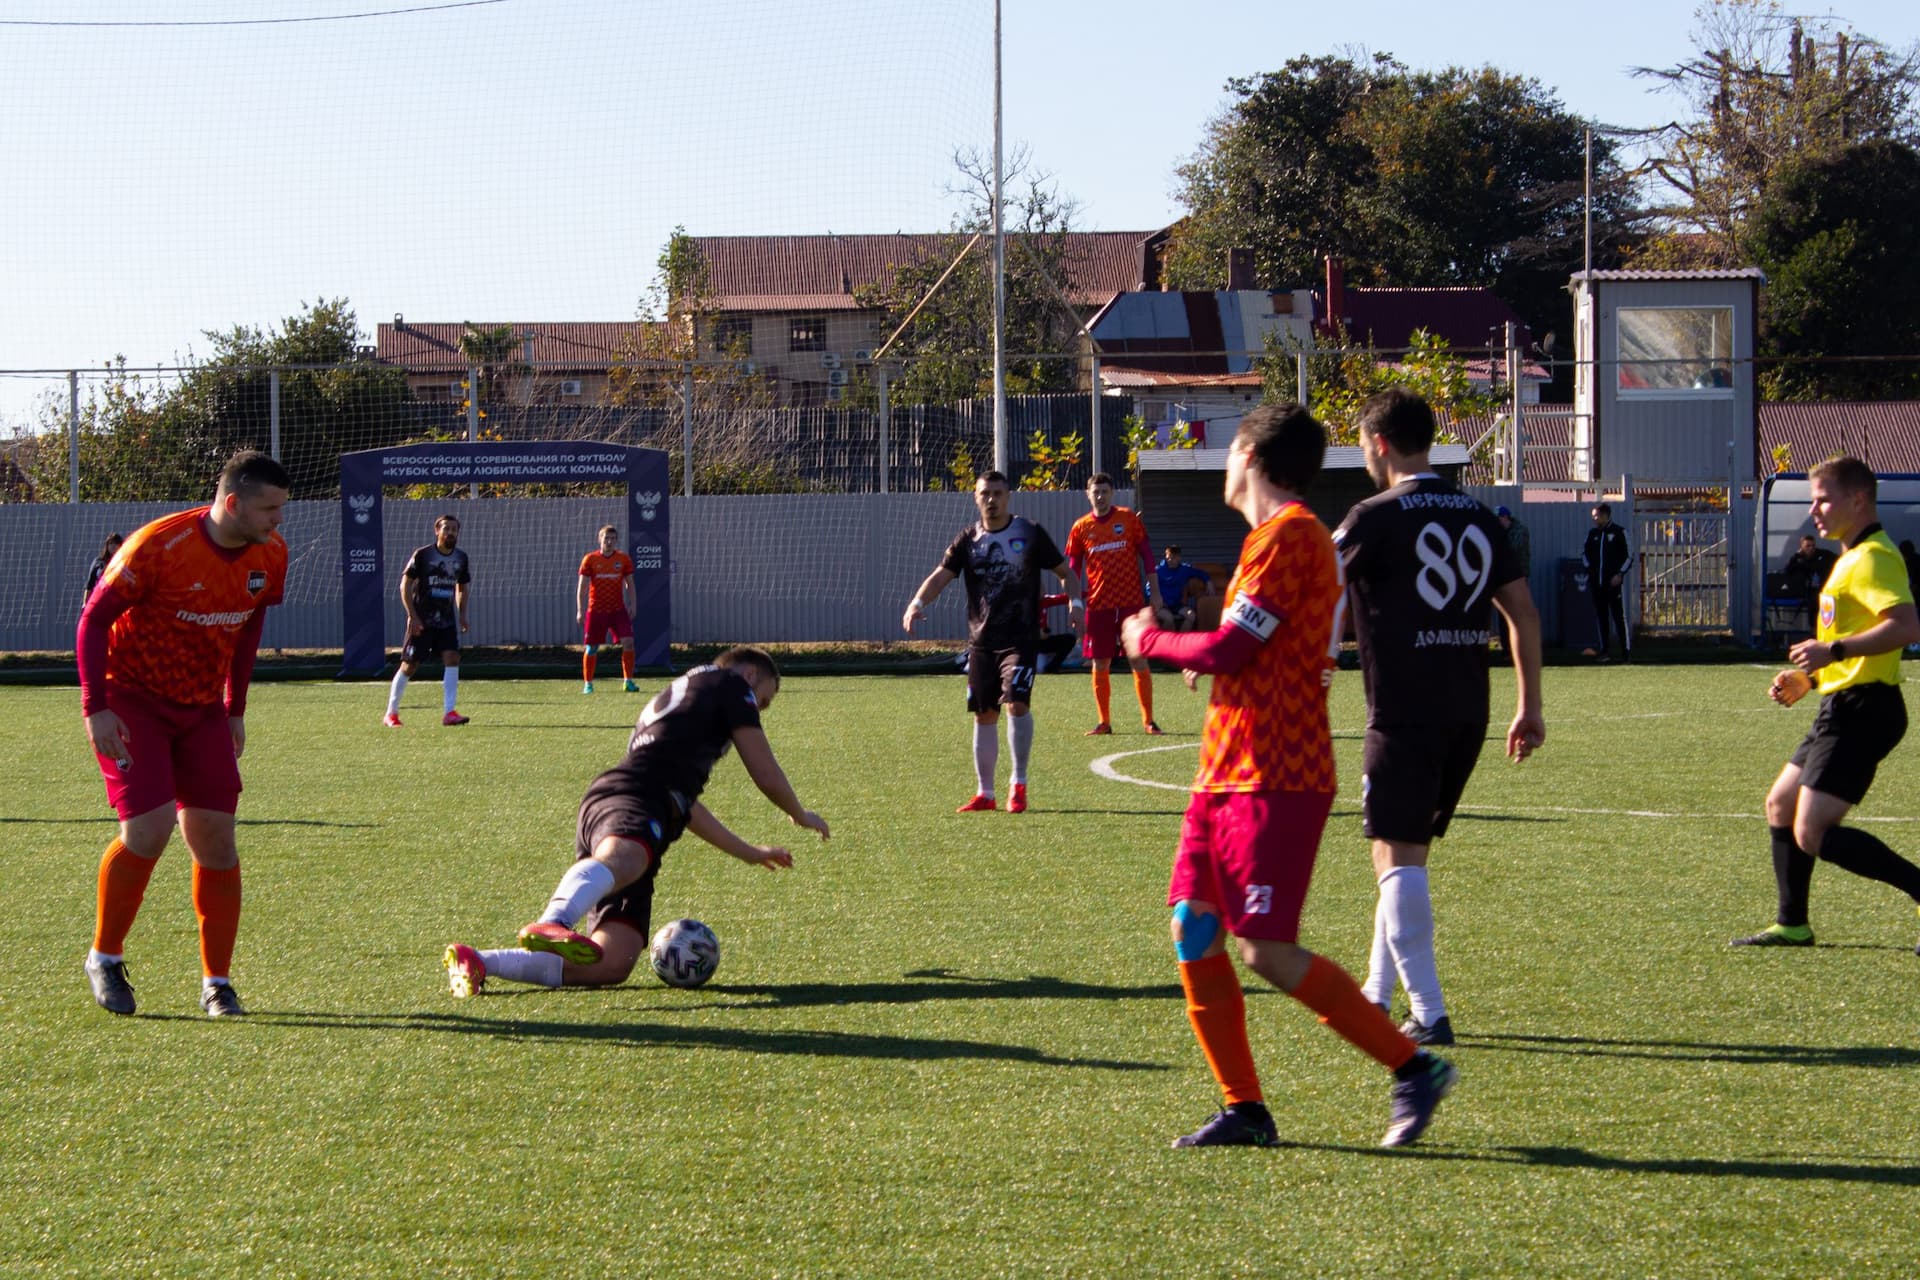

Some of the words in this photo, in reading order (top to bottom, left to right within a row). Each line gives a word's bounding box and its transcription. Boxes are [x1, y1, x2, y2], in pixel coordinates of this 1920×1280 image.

[383, 455, 472, 465] ВСЕРОССИЙСКИЕ
[474, 454, 558, 464] СОРЕВНОВАНИЯ
[560, 454, 575, 463] ПО
[577, 453, 626, 463] ФУТБОЛУ
[383, 466, 429, 476] «КУБОК
[432, 466, 470, 476] СРЕДИ
[473, 465, 567, 475] ЛЮБИТЕЛЬСКИХ
[570, 464, 627, 475] КОМАНД»
[350, 549, 376, 557] СОЧИ
[636, 545, 662, 554] СОЧИ
[350, 563, 376, 572] 2021
[636, 559, 662, 569] 2021
[1415, 521, 1493, 613] 89
[1235, 599, 1267, 629] AIN
[1244, 884, 1273, 914] 23
